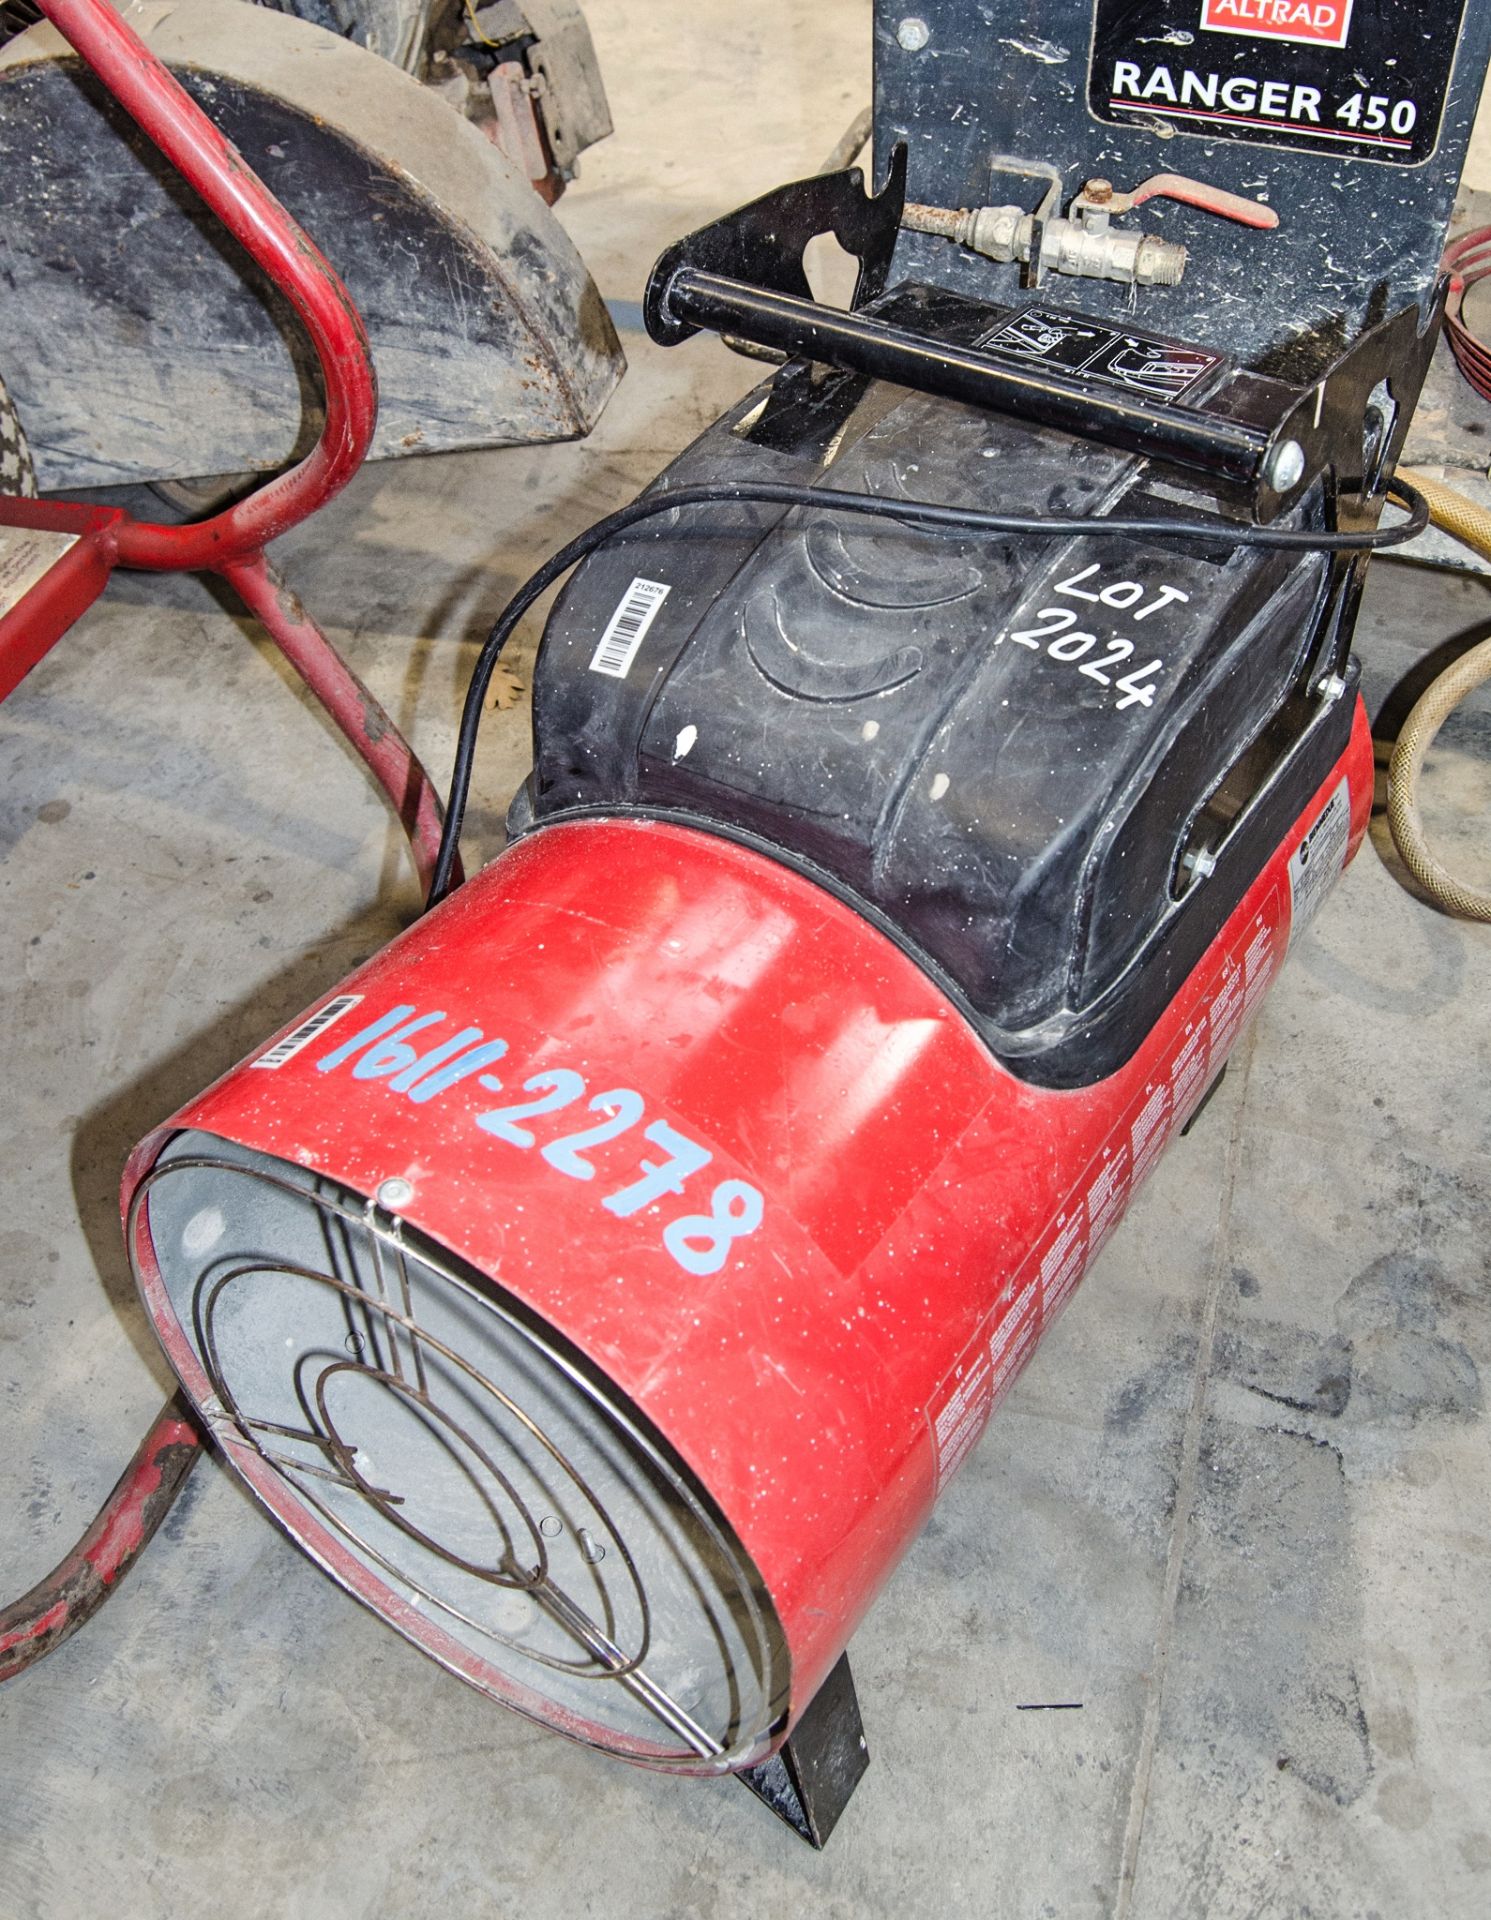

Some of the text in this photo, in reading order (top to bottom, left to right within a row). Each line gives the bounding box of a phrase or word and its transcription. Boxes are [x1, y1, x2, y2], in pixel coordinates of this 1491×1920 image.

[1215, 0, 1337, 28] ALTRAD
[1112, 61, 1417, 135] RANGER 450
[1053, 563, 1190, 621] LOT
[1010, 607, 1163, 711] 2024
[315, 1004, 764, 1275] 1611-2278
